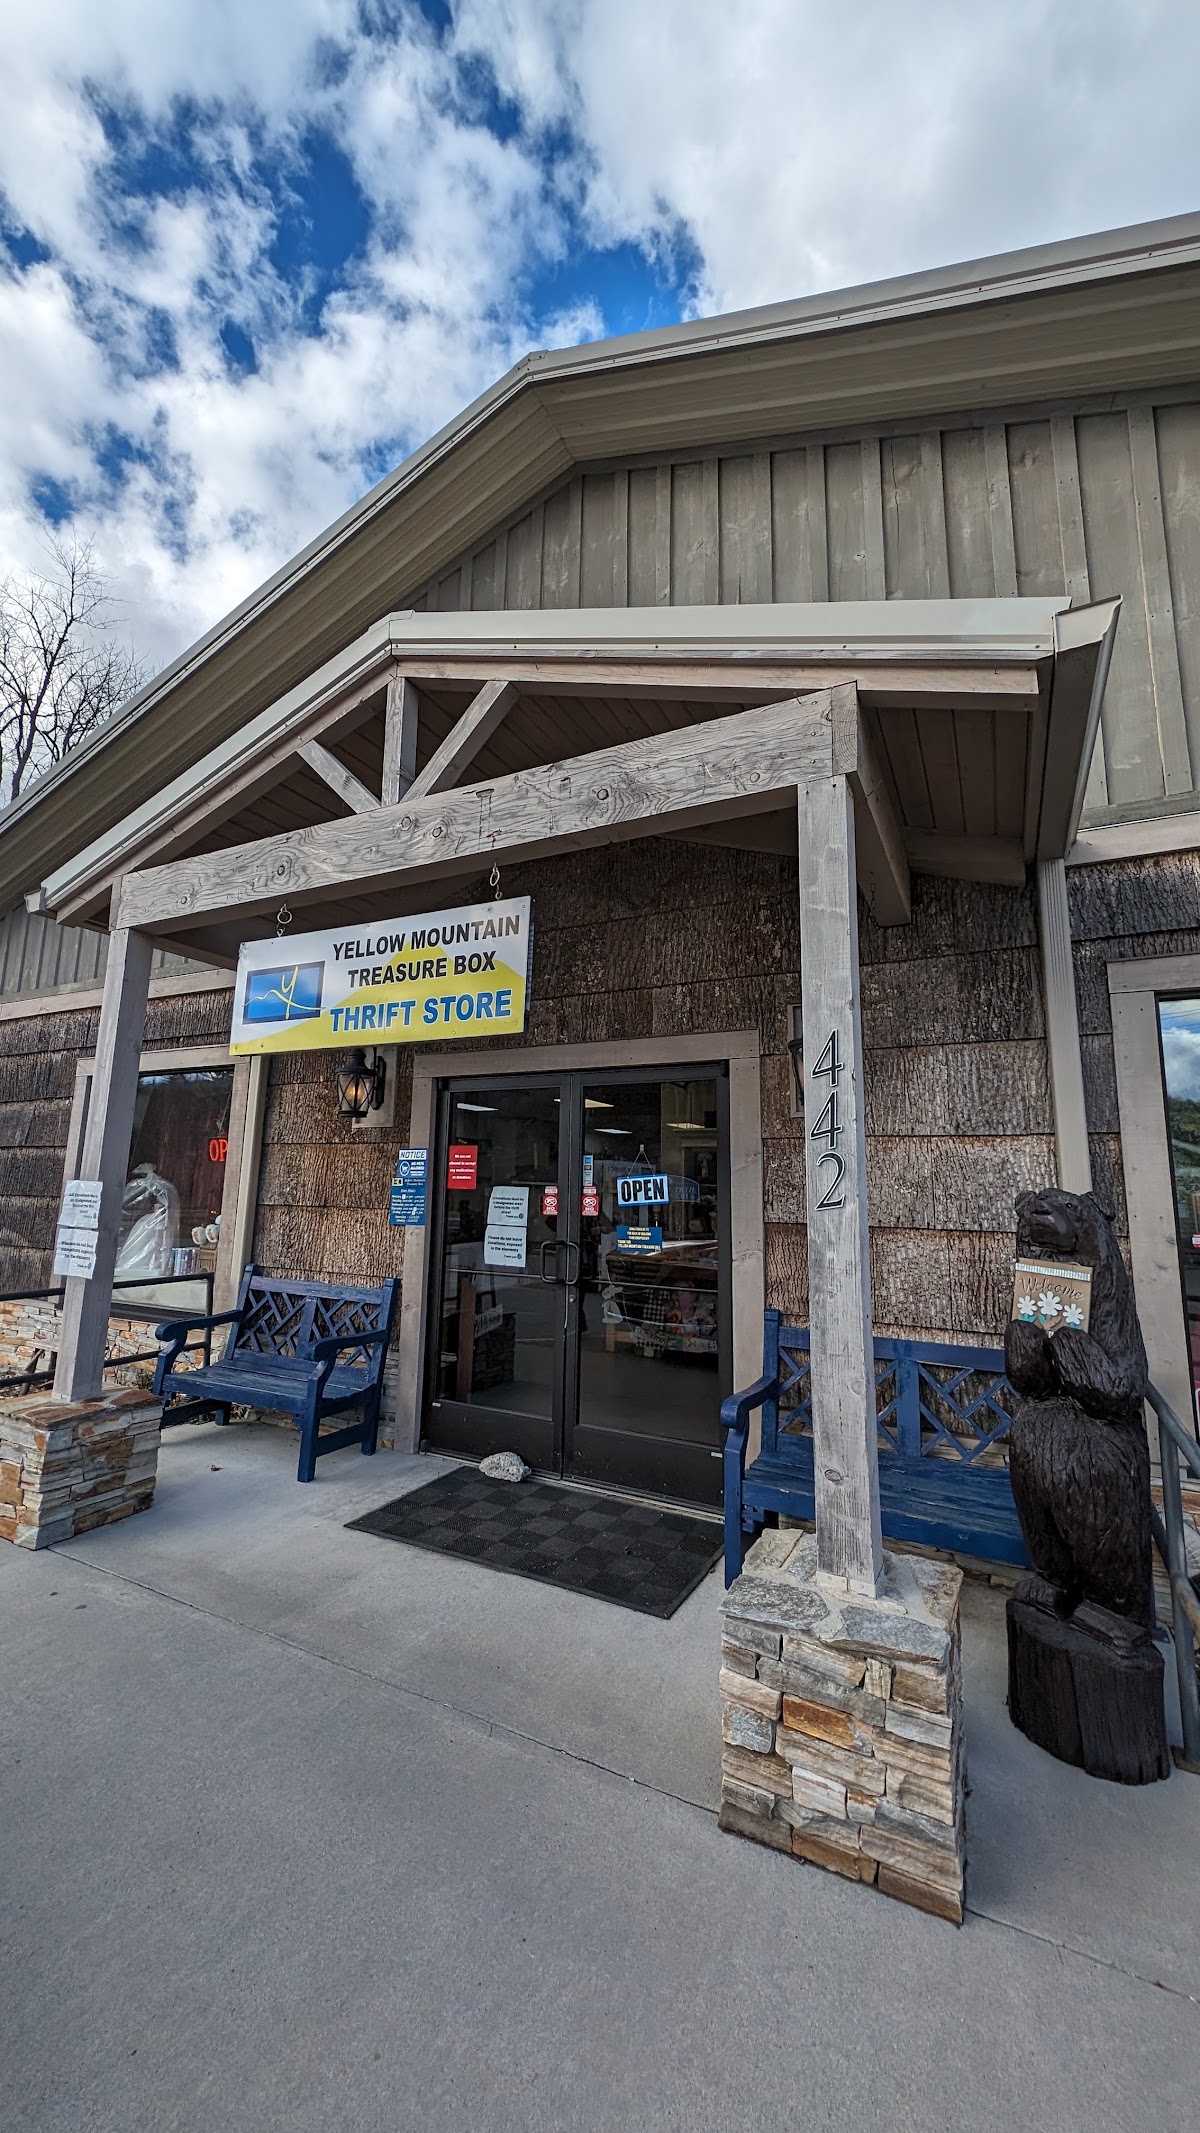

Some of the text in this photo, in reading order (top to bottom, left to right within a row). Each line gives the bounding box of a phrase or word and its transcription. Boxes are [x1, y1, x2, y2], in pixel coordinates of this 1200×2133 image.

[332, 914, 521, 961] YELLOW MOUNTAIN
[347, 950, 497, 988] TREASURE BOX
[329, 989, 513, 1032] THRIFT STORE
[399, 1151, 426, 1159] NOTICE
[620, 1178, 665, 1203] OPEN
[1018, 1276, 1085, 1301] Welcome
